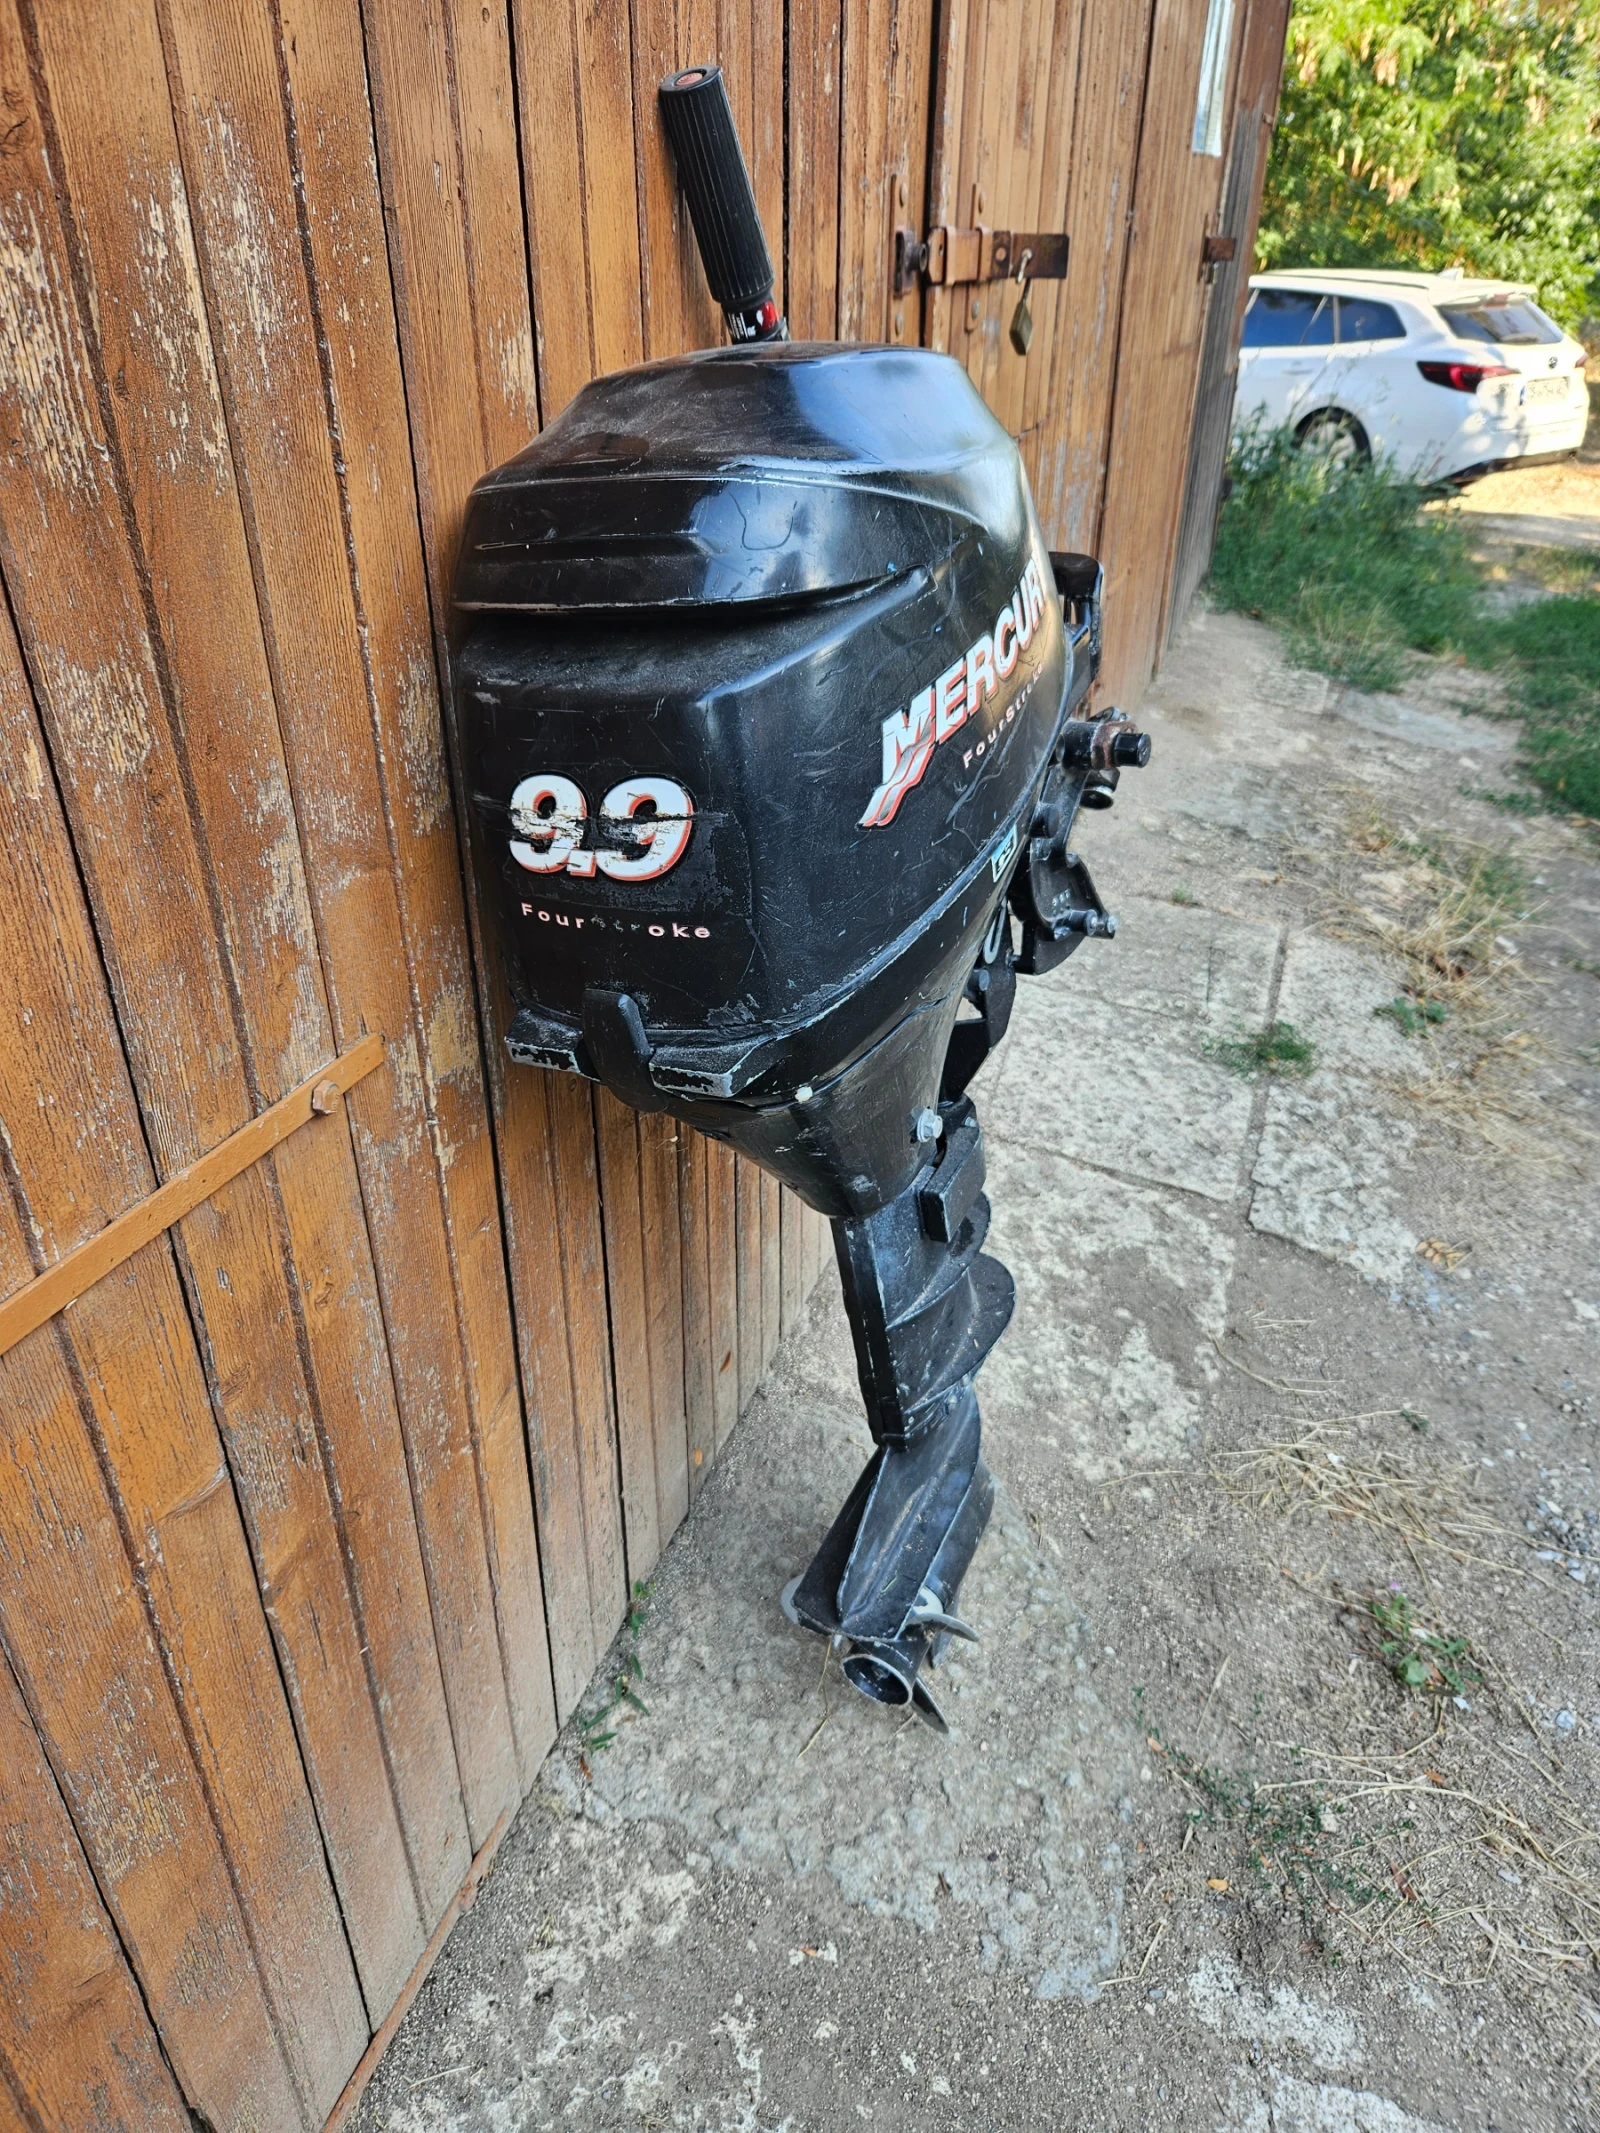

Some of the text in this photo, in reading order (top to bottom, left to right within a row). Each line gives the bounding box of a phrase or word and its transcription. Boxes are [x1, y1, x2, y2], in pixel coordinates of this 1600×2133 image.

[876, 558, 1046, 785] MERCUR
[963, 662, 1043, 769] FourStroke
[509, 774, 693, 882] 9.9
[521, 902, 711, 939] Fourtoke
